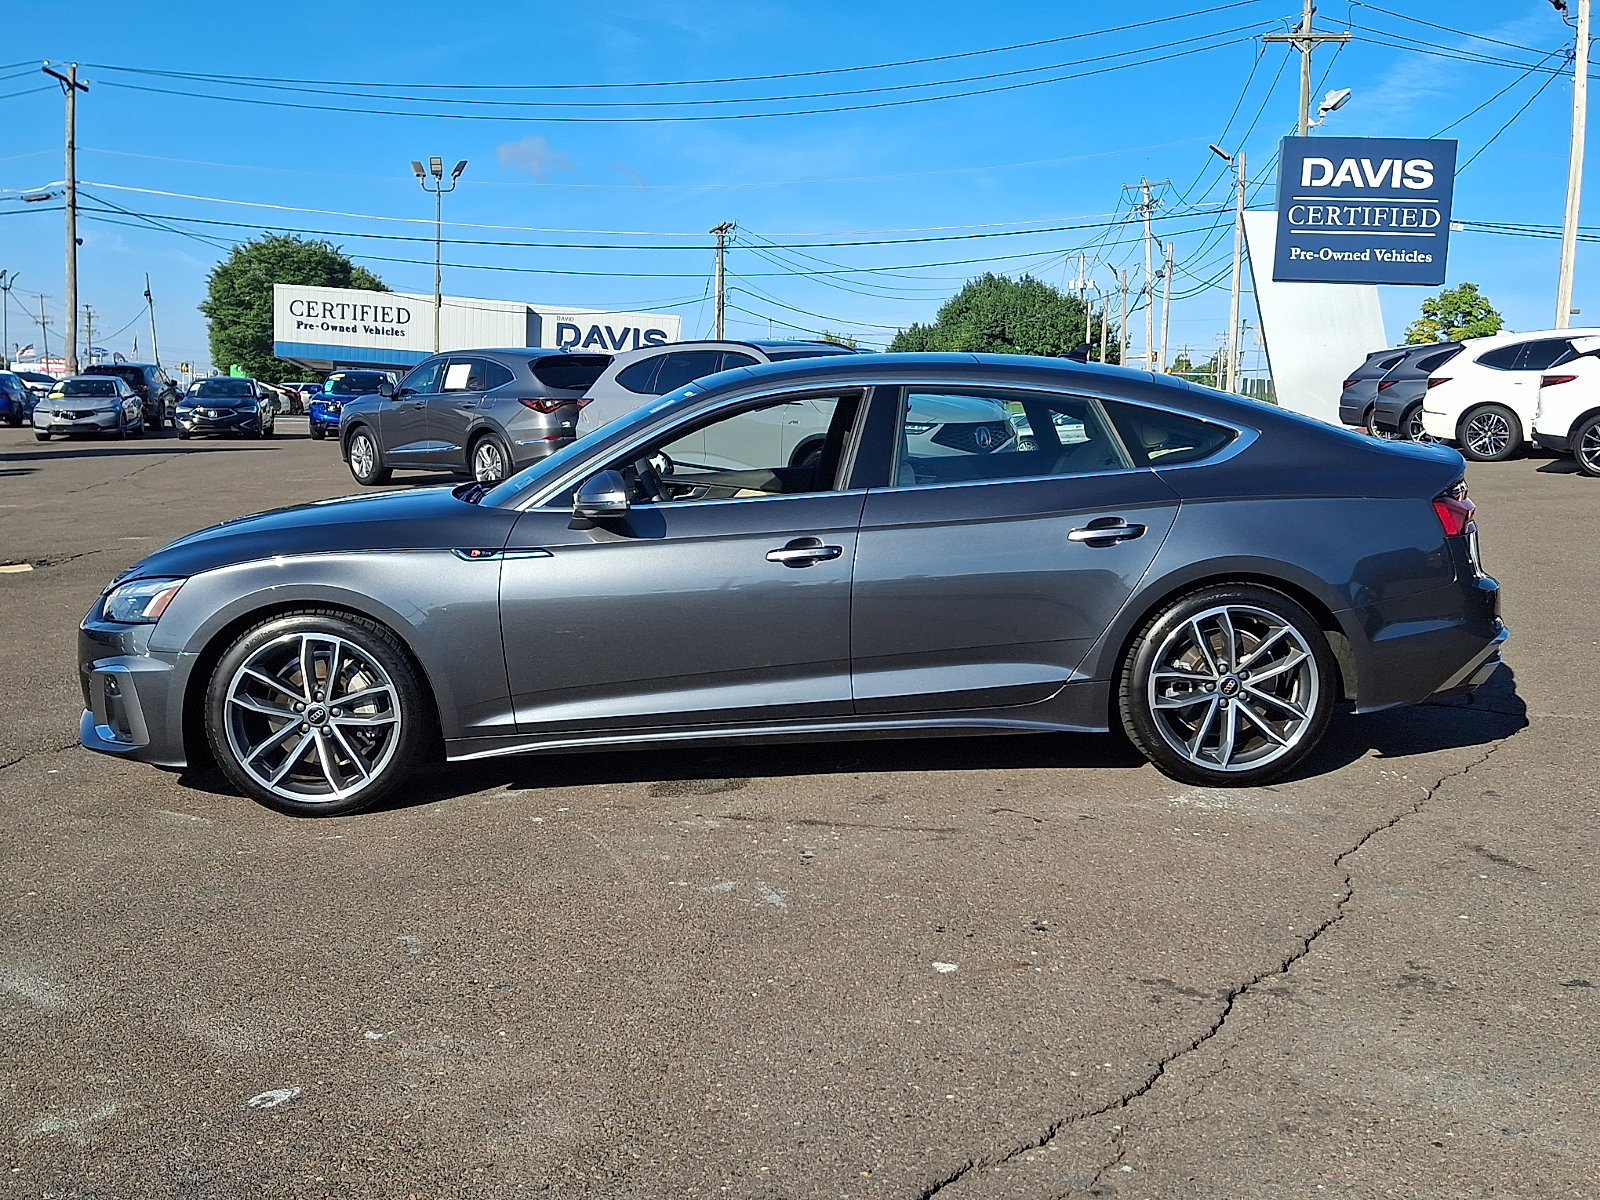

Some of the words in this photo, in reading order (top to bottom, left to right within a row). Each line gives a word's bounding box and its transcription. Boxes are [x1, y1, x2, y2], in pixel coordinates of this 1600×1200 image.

[1300, 157, 1435, 190] DAVIS
[1287, 205, 1442, 229] CERTIFIED
[1289, 247, 1371, 262] Pre-Owned
[1374, 249, 1433, 263] Vehicles
[289, 299, 411, 324] CERTIFIED
[296, 320, 358, 333] Pre-Owned
[363, 324, 406, 337] Vehicles
[555, 322, 668, 351] DAVIS
